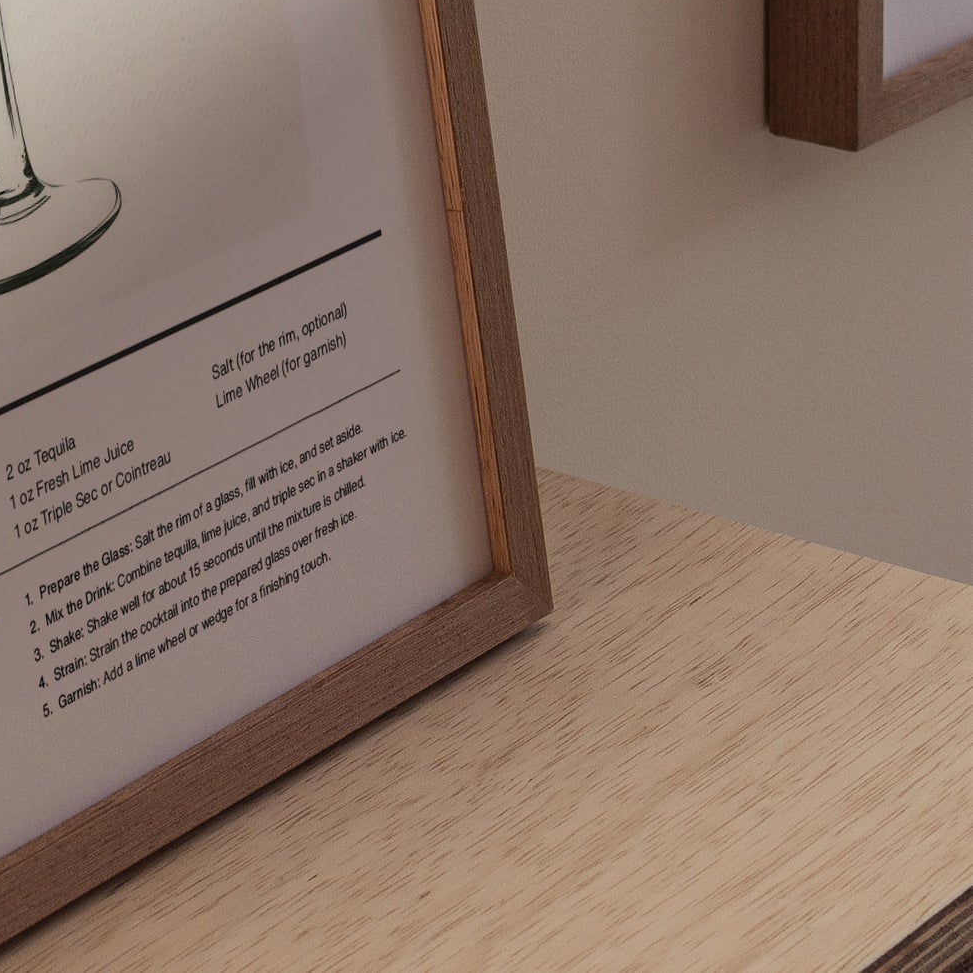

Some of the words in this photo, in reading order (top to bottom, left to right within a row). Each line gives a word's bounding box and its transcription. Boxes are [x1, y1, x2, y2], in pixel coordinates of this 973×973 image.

[211, 357, 235, 380] Salt
[236, 348, 256, 372] (for
[257, 339, 276, 358] the
[278, 329, 300, 348] rim,
[301, 301, 348, 337] optional)
[215, 385, 243, 409] Lime
[244, 363, 280, 393] Wheel
[281, 355, 301, 379] (for
[303, 330, 347, 368] garnish)
[5, 463, 15, 481] 2
[17, 458, 32, 475] oz
[33, 436, 77, 466] Tequila
[9, 494, 16, 510] 1
[19, 488, 35, 506] oz
[35, 469, 70, 498] Fresh
[71, 456, 101, 480] Lime
[103, 439, 135, 464] Juice
[14, 523, 21, 539] 1
[23, 517, 40, 535] oz
[39, 500, 73, 526] Triple
[75, 488, 99, 509] Sec
[100, 479, 113, 497] or
[115, 451, 172, 489] Cointreau
[24, 592, 34, 607] 1.
[38, 570, 81, 600] Prepare
[82, 560, 100, 577] the
[101, 542, 134, 567] Glass:
[134, 528, 156, 550] Salt
[156, 521, 174, 538] the
[175, 512, 192, 529] rim
[192, 502, 204, 520] of
[205, 501, 214, 514] a
[214, 487, 244, 512] glass,
[244, 475, 257, 493] fill
[257, 465, 279, 485] with
[279, 458, 298, 475] ice,
[299, 443, 318, 465] and
[318, 436, 335, 454] set
[335, 424, 364, 446] aside.
[29, 619, 41, 635] 2.
[44, 608, 65, 627] Mix
[65, 598, 84, 616] the
[84, 581, 116, 606] Drink:
[116, 556, 162, 588] Combine
[163, 538, 200, 564] tequila,
[200, 525, 222, 544] lime
[223, 512, 251, 537] juice,
[251, 496, 271, 518] and
[271, 485, 297, 507] triple
[298, 476, 316, 493] sec
[316, 470, 327, 483] in
[328, 466, 336, 477] a
[336, 447, 368, 473] shaker
[368, 436, 389, 455] with
[390, 429, 408, 444] ice.
[33, 647, 45, 663] 3.
[49, 627, 85, 654] Shake:
[86, 609, 119, 634] Shake
[119, 594, 141, 616] well
[141, 588, 156, 604] for
[158, 570, 188, 596] about
[188, 561, 201, 579] 15
[202, 542, 245, 572] seconds
[245, 526, 267, 550] until
[267, 521, 284, 537] the
[285, 500, 322, 528] mixture
[322, 494, 332, 508] is
[333, 475, 366, 502] chilled.
[38, 675, 49, 689] 4.
[53, 655, 88, 682] Strain:
[89, 637, 120, 663] Strain
[120, 628, 139, 645] the
[139, 603, 179, 635] cocktail
[180, 594, 200, 613] into
[200, 585, 218, 602] the
[219, 557, 264, 596] prepared
[264, 545, 291, 571] glass
[291, 532, 313, 553] over
[314, 517, 340, 540] fresh
[339, 510, 358, 526] ice.
[42, 702, 53, 718] 5.
[57, 677, 101, 709] Garnish:
[102, 662, 124, 686] Add
[126, 660, 134, 673] a
[134, 648, 156, 668] lime
[156, 627, 187, 655] wheel
[188, 623, 199, 638] or
[200, 605, 234, 631] wedge
[234, 596, 250, 612] for
[250, 592, 259, 604] a
[258, 568, 300, 599] finishing
[300, 551, 332, 576] touch.
